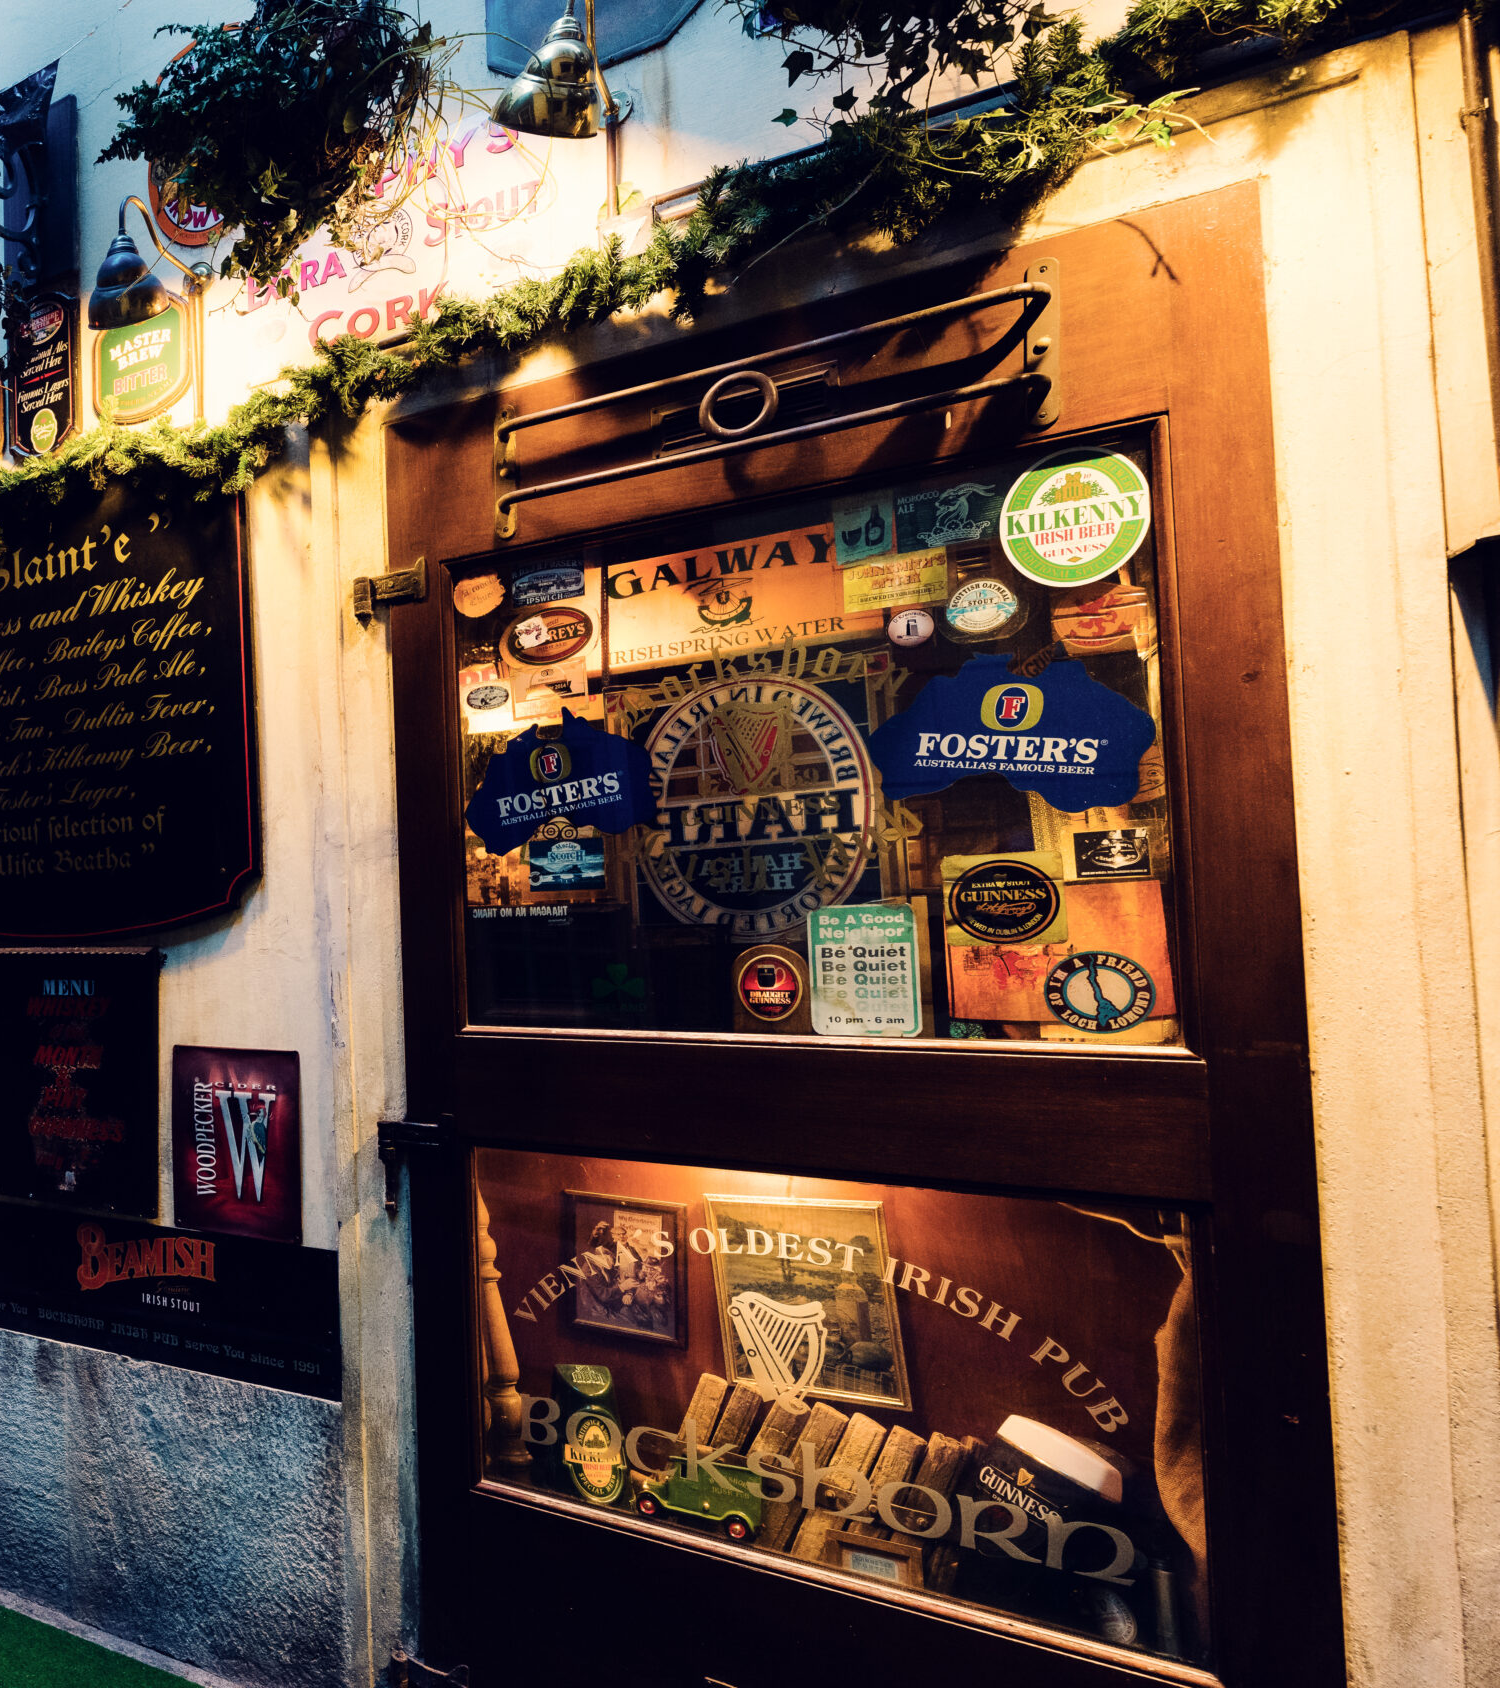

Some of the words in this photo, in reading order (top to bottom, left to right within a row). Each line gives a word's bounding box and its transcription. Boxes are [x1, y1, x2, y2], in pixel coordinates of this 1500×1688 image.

[424, 180, 543, 247] STOUT
[308, 280, 449, 347] CORK
[108, 328, 171, 361] MASTER
[117, 343, 165, 371] BREW
[44, 355, 63, 370] Here
[17, 386, 44, 404] Famous
[44, 377, 70, 395] Lagers
[113, 363, 167, 396] BITTER
[20, 398, 44, 414] Served
[44, 391, 64, 407] Here
[897, 490, 939, 505] MOROCCO
[897, 503, 915, 515] ALE
[1006, 494, 1144, 536] KILKENNY
[1035, 528, 1074, 546] IRISH
[1078, 522, 1116, 540] BEER
[1043, 543, 1107, 558] GUINNESS
[608, 534, 831, 600] GALWAY
[29, 590, 88, 632] and
[88, 567, 204, 618] Whiskey
[526, 594, 563, 605] IPSWICH
[952, 583, 980, 608] SCOTTISH
[982, 582, 1011, 601] OATMEAL
[967, 598, 994, 606] STOUT
[43, 633, 125, 665] Baileys
[132, 612, 212, 652] Coffee,
[609, 644, 663, 666] IRISH
[668, 628, 750, 658] SPRING
[755, 616, 845, 645] WATER
[34, 674, 87, 702] Bass
[93, 658, 147, 691] Pale
[153, 649, 207, 681] Ale,
[5, 716, 53, 743] Tan,
[63, 702, 134, 735] Dublin
[141, 693, 215, 722] Fever,
[999, 696, 1025, 720] F
[37, 744, 134, 773] Kilkenny
[141, 730, 212, 759] Beer,
[915, 733, 1099, 764] FOSTER'S
[541, 753, 558, 775] F
[914, 758, 997, 771] AUSTRALIA'S
[999, 762, 1056, 773] FAMOUS
[1058, 765, 1096, 776] BEER
[59, 778, 136, 810] Lager,
[497, 772, 621, 818] FOSTER'S
[142, 805, 166, 834] of
[501, 808, 557, 827] AUSTRALIA'S
[558, 799, 597, 815] FAMOUS
[598, 793, 622, 807] BEER
[681, 796, 841, 827] GUINNESS
[549, 850, 585, 863] SCOTCH
[960, 888, 1046, 902] GUINNESS
[818, 915, 839, 926] Be
[844, 915, 856, 925] A
[861, 912, 905, 925] Good
[818, 926, 905, 940] Neighbor
[821, 947, 846, 958] Be
[852, 945, 906, 959] Quiet
[822, 960, 847, 972] Be
[853, 960, 907, 973] Quiet
[1049, 969, 1068, 987] I'M
[1073, 957, 1084, 968] A
[1096, 954, 1149, 988] FRIEND
[42, 979, 96, 996] MENU
[822, 973, 847, 986] Be
[854, 973, 907, 986] Quiet
[749, 991, 791, 999] DRAUGHT
[749, 997, 791, 1005] GUINNESS
[854, 986, 908, 999] Quiet
[1048, 992, 1063, 1006] OF
[828, 1016, 841, 1024] 10
[846, 1016, 864, 1025] pm
[875, 1016, 882, 1024] 6
[1061, 1010, 1098, 1030] LOCH
[1110, 990, 1150, 1030] LOMOND
[213, 1081, 277, 1091] CIDER
[194, 1081, 217, 1196] WOODPECKER
[215, 1091, 277, 1202] W
[77, 1222, 216, 1292] BEAMISH
[141, 1292, 168, 1308] IRISH
[170, 1297, 200, 1313] STOUT
[11, 1303, 28, 1316] You
[37, 1307, 105, 1331] BOCKSHORN
[153, 1331, 179, 1347] PUB
[185, 1339, 220, 1355] serve
[223, 1344, 245, 1361] You
[250, 1352, 285, 1369] since
[292, 1359, 321, 1376] 1991
[513, 1227, 675, 1323] VIENNA'S
[689, 1227, 865, 1273] OLDEST
[881, 1256, 1022, 1342] IRISH
[1029, 1336, 1129, 1433] PUB
[579, 1472, 604, 1495] SPECIAL
[979, 1466, 1061, 1521] GUINNESS
